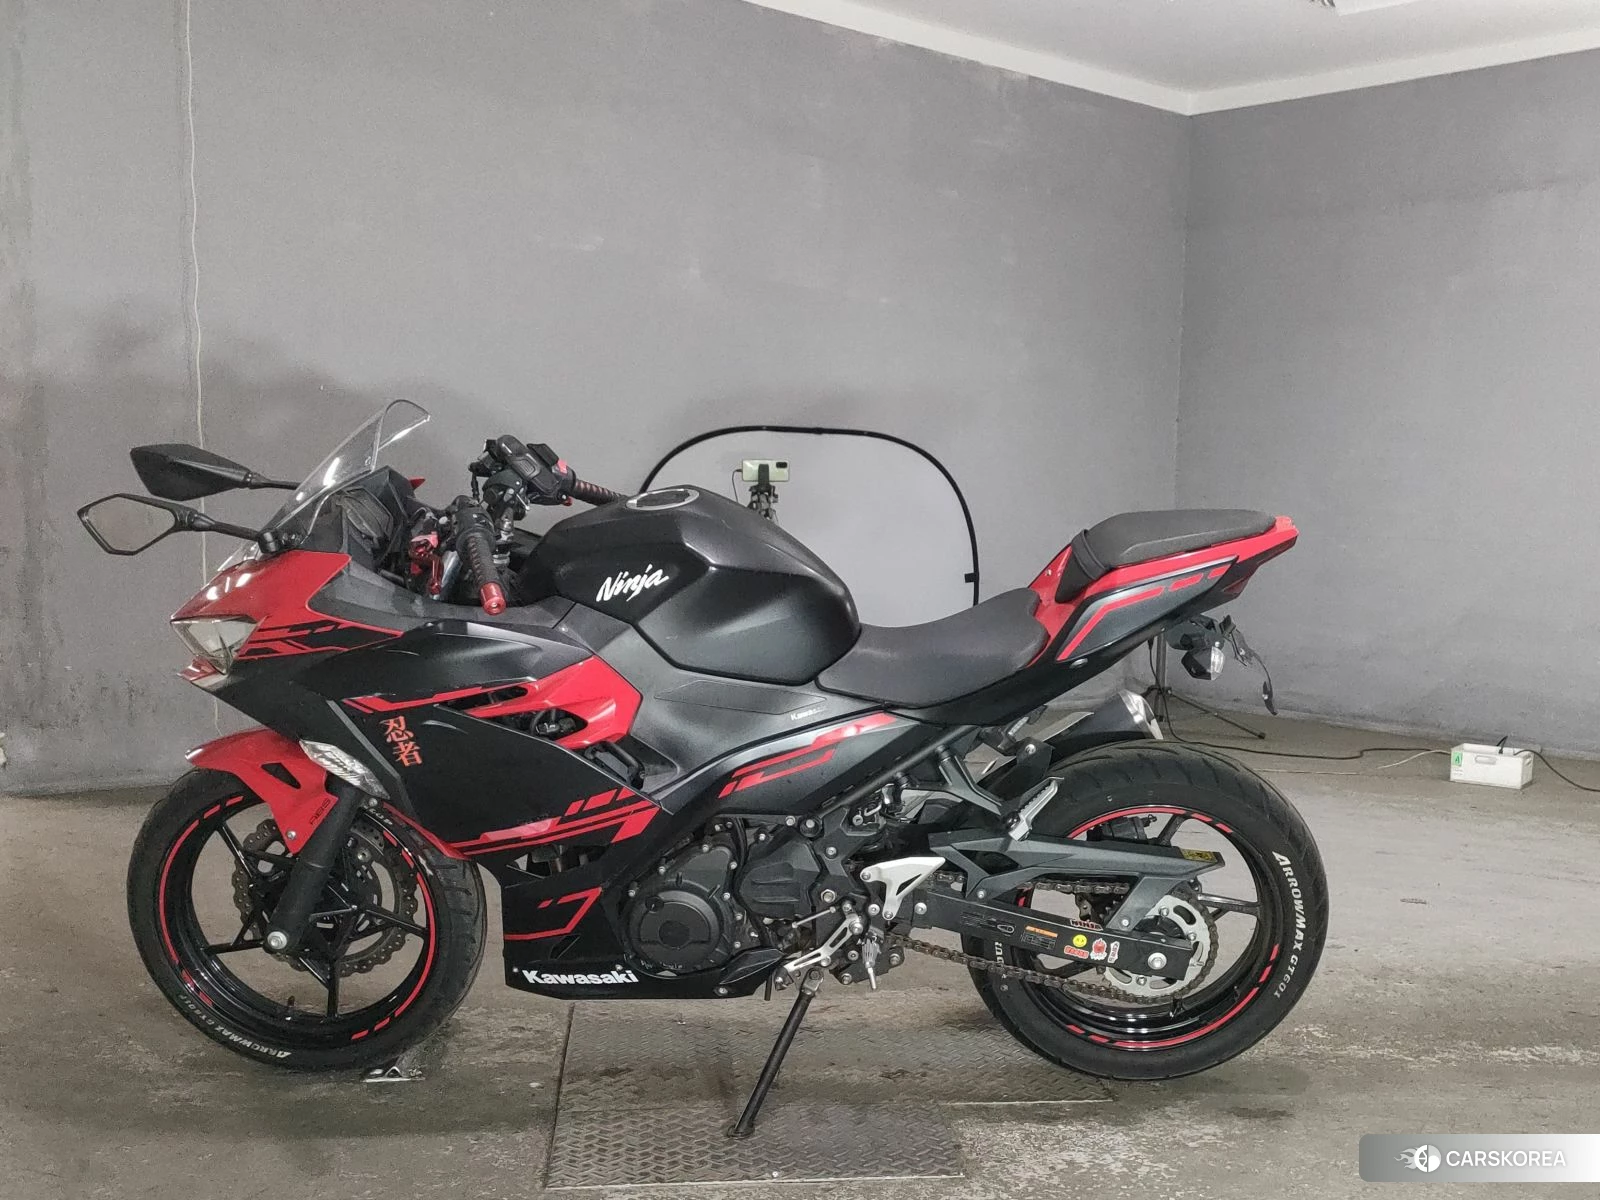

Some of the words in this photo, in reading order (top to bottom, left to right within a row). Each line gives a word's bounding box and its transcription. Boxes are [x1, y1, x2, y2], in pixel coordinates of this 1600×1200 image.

[596, 563, 670, 602] Ninja
[379, 715, 422, 767] 忍者
[1272, 851, 1307, 951] ARROWMAX
[522, 970, 639, 985] Kawasaki
[1273, 954, 1299, 998] GT601
[215, 1024, 292, 1059] ARROWMAX
